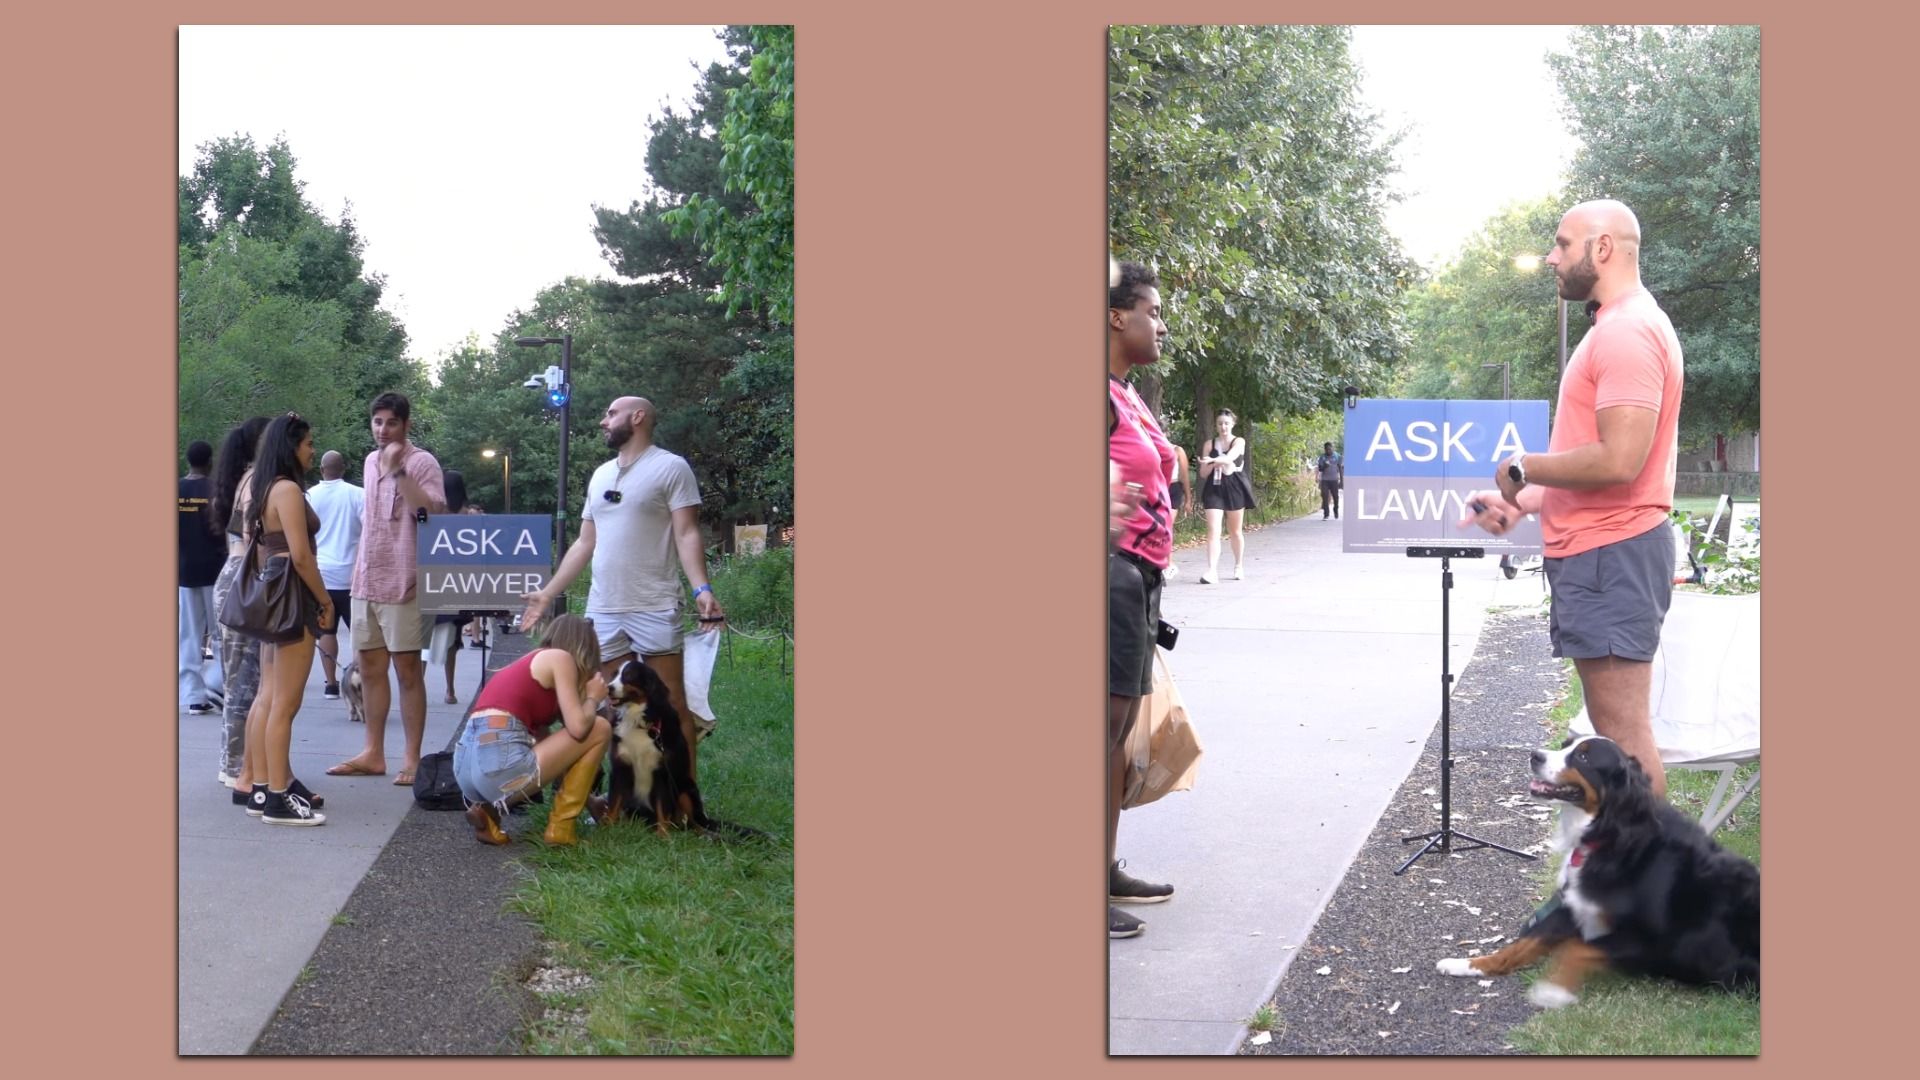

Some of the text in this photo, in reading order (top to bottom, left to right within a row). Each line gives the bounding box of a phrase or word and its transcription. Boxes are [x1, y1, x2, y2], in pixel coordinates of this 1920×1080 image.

[1365, 421, 1527, 462] ASK A
[1357, 489, 1536, 522] LAWY
[430, 528, 538, 556] ASK A
[425, 572, 543, 594] LAWYER
